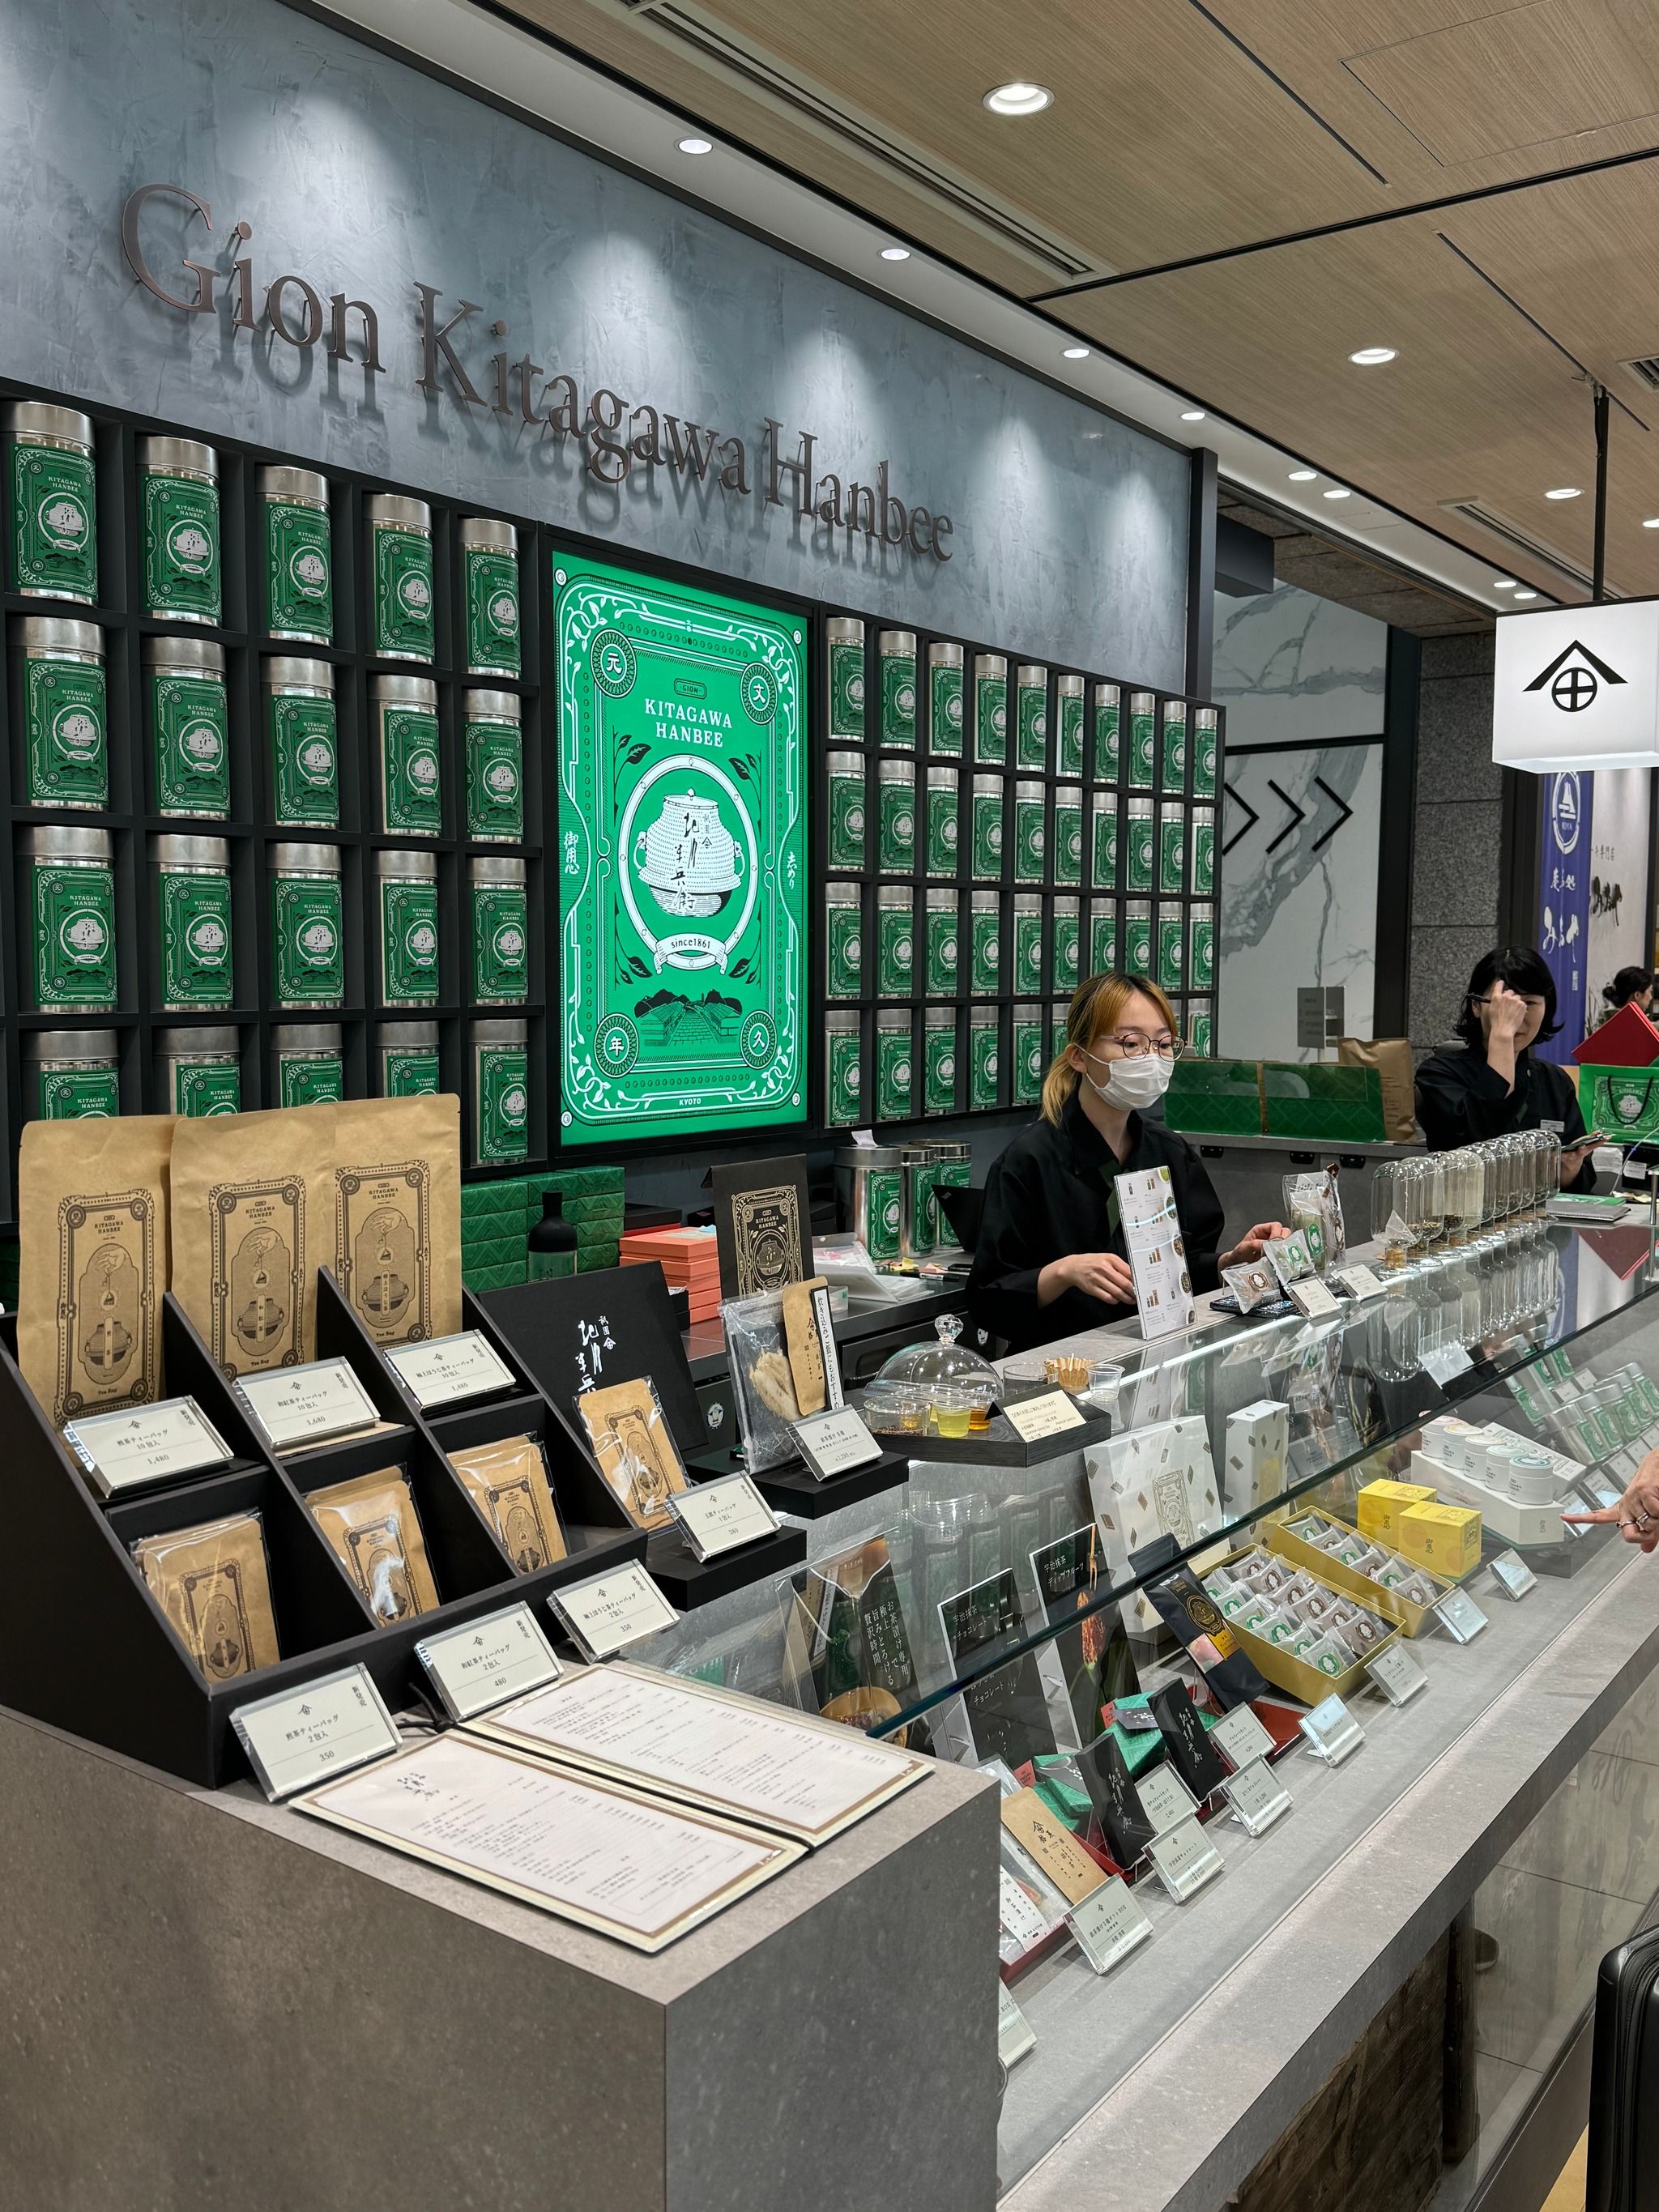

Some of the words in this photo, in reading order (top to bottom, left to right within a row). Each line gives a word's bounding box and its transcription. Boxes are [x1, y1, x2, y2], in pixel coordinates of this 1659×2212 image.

[122, 183, 386, 373] Gion
[413, 280, 751, 495] Kitagawa
[765, 418, 953, 562] Hanbee
[607, 654, 623, 674] 元
[682, 684, 699, 694] GION
[753, 683, 766, 703] 文
[644, 698, 733, 728] KITAGAWA
[655, 722, 723, 748] HANBEE
[564, 831, 580, 875] 御用心
[608, 1037, 625, 1056] 年
[752, 1030, 766, 1049] 久
[679, 1097, 702, 1106] KYOTO
[369, 1187, 399, 1196] KITAGAWA
[245, 1206, 275, 1214] KITAGAWA
[94, 1221, 124, 1229] KITAGAWA
[98, 1226, 121, 1234] HANBEE
[277, 1390, 328, 1408] 和紅茶ティーバッグ
[297, 1400, 318, 1411] 10包入
[306, 1416, 326, 1426] 1,680
[117, 1429, 168, 1447] 煎茶ティーバッグ
[137, 1439, 161, 1451] 10包入
[147, 1454, 169, 1465] 1,480
[1043, 1554, 1068, 1572] 宇治抹茶
[1047, 1562, 1085, 1588] ディップフルーツ
[608, 1608, 625, 1618] 2包入
[953, 1605, 978, 1624] 宇治抹茶
[621, 1623, 632, 1633] 350
[957, 1620, 987, 1640] チョコレート
[864, 1613, 881, 1666] 贅沢時間
[872, 1609, 894, 1686] 旨みとろける
[887, 1600, 909, 1677] お茶漬け専用
[461, 1643, 510, 1669] 和紅茶ティーバッグ
[483, 1659, 501, 1671] 2包入
[494, 1677, 507, 1687] 480
[974, 1682, 1004, 1705] チョコレート
[285, 1714, 339, 1741] 煎茶ティーバッグ
[308, 1730, 329, 1743] 2包入
[319, 1750, 335, 1762] 350
